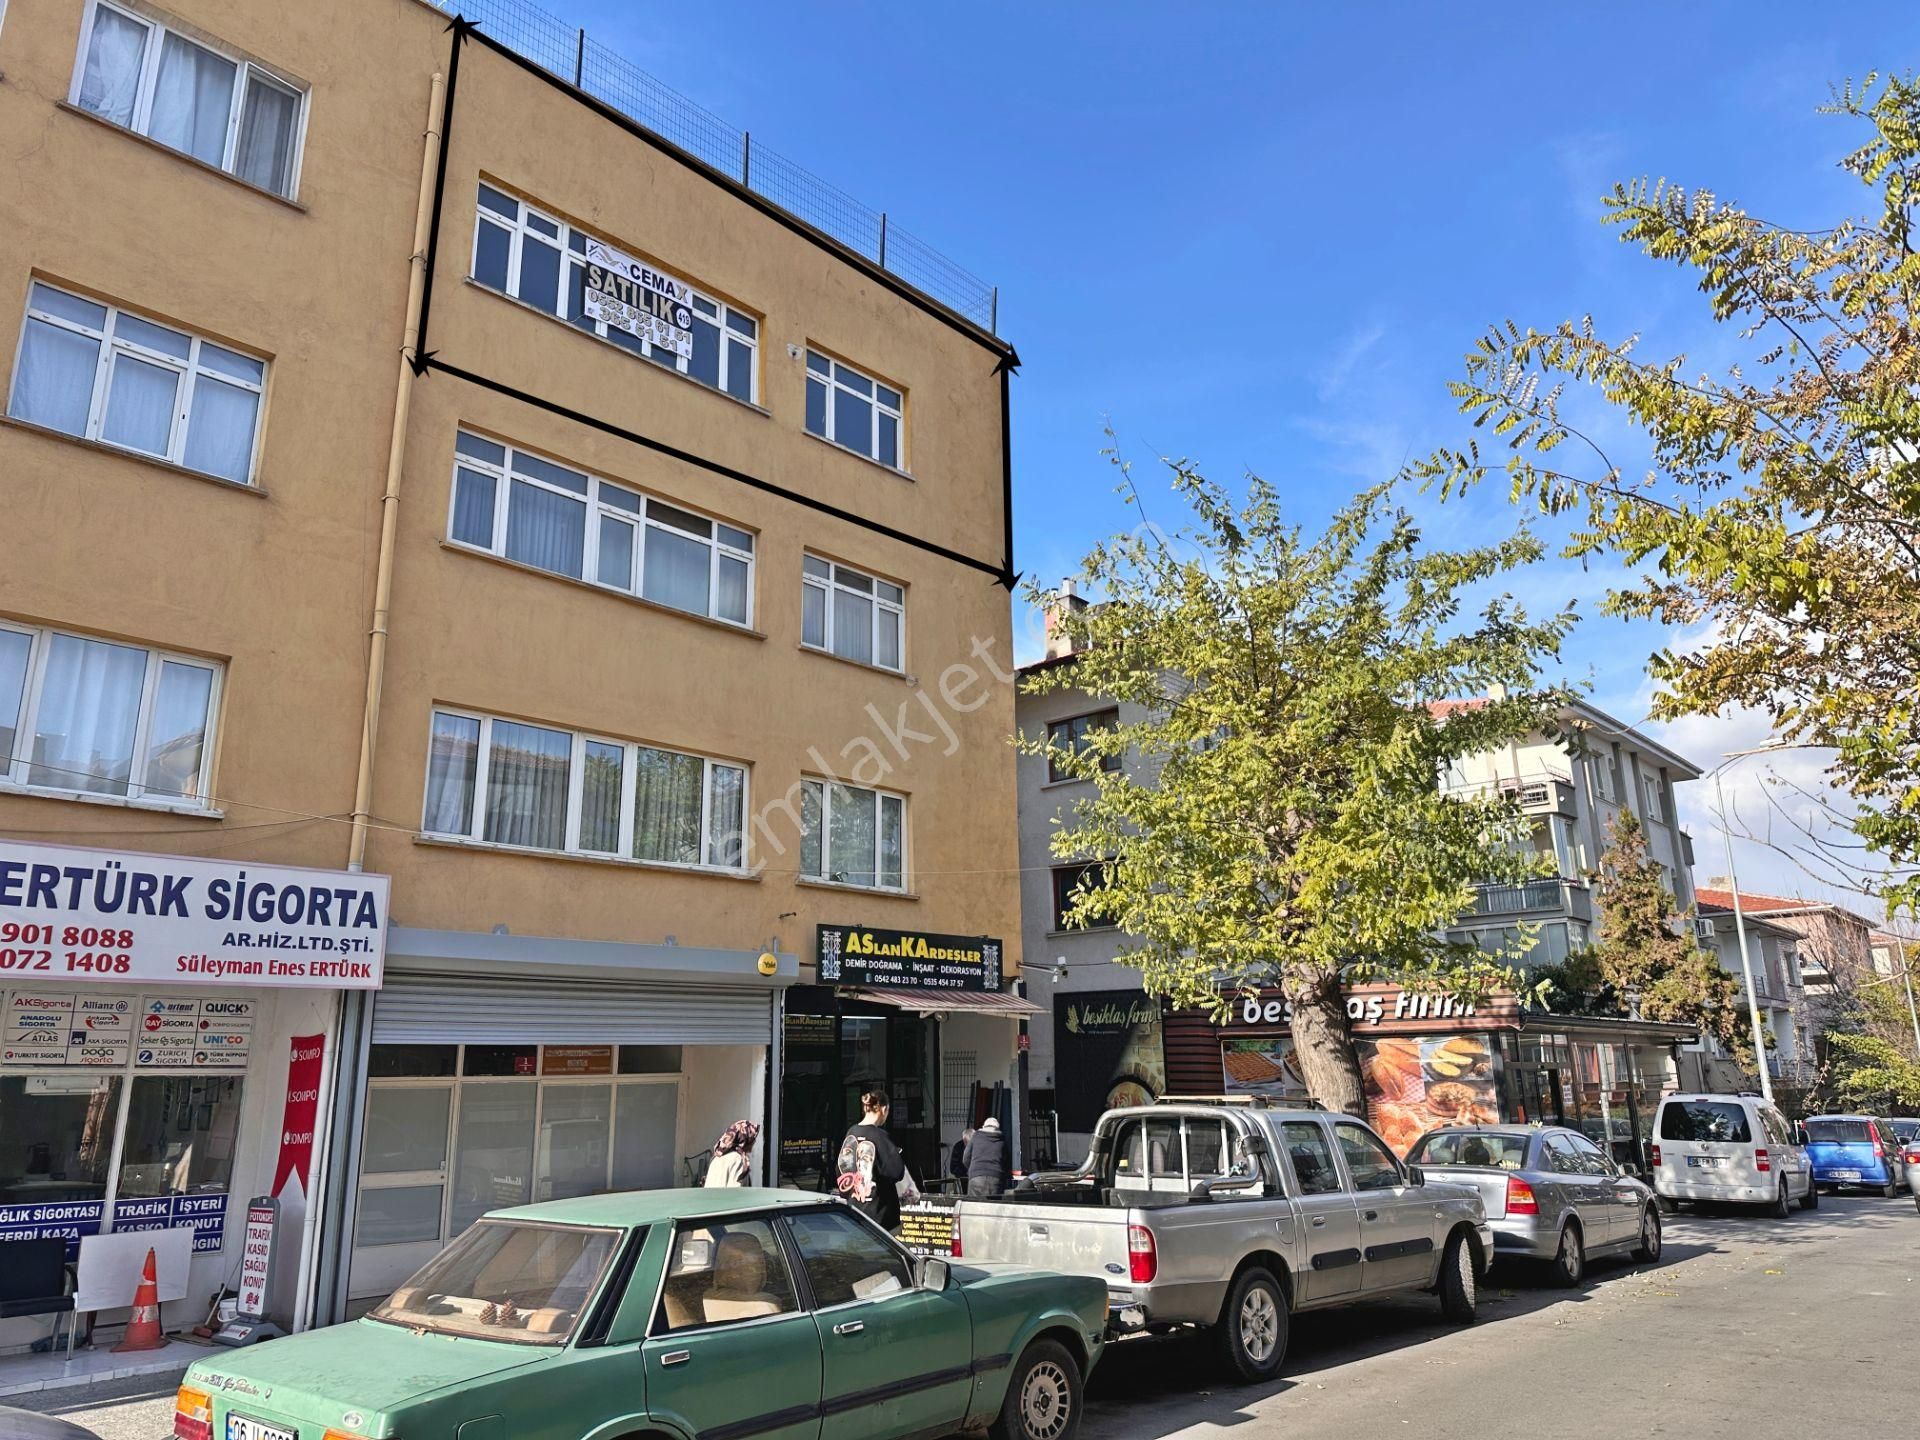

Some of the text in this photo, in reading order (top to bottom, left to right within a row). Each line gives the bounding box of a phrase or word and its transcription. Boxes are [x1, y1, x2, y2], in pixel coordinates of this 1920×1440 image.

[630, 264, 688, 304] CEMAX
[588, 265, 674, 324] SATILIK
[0, 861, 378, 930] ERTÜRK SİGORTA
[0, 922, 134, 949] 901 8088
[0, 948, 131, 973] 072 1408
[176, 954, 372, 979] Süleyman Enes ERTÜRK
[845, 958, 867, 968] DEMİR
[868, 960, 902, 970] DOĞRAMA
[940, 965, 982, 976] DEKORASYON
[82, 1001, 114, 1009] Allianz
[205, 1003, 243, 1013] QUICK
[162, 1019, 194, 1027] SİGORTA
[170, 1036, 193, 1046] Sigorta
[299, 1048, 320, 1061] SOMPO
[291, 1090, 317, 1102] SOMPO
[33, 1206, 100, 1220] SİGORTASI
[117, 1197, 223, 1217] TRAFİK İŞYERİ
[175, 1218, 222, 1229] KONUT
[42, 1227, 79, 1239] KAZA
[247, 1243, 268, 1256] KASKO
[244, 1257, 268, 1272] SAĞLIK
[244, 1276, 265, 1289] KONUT
